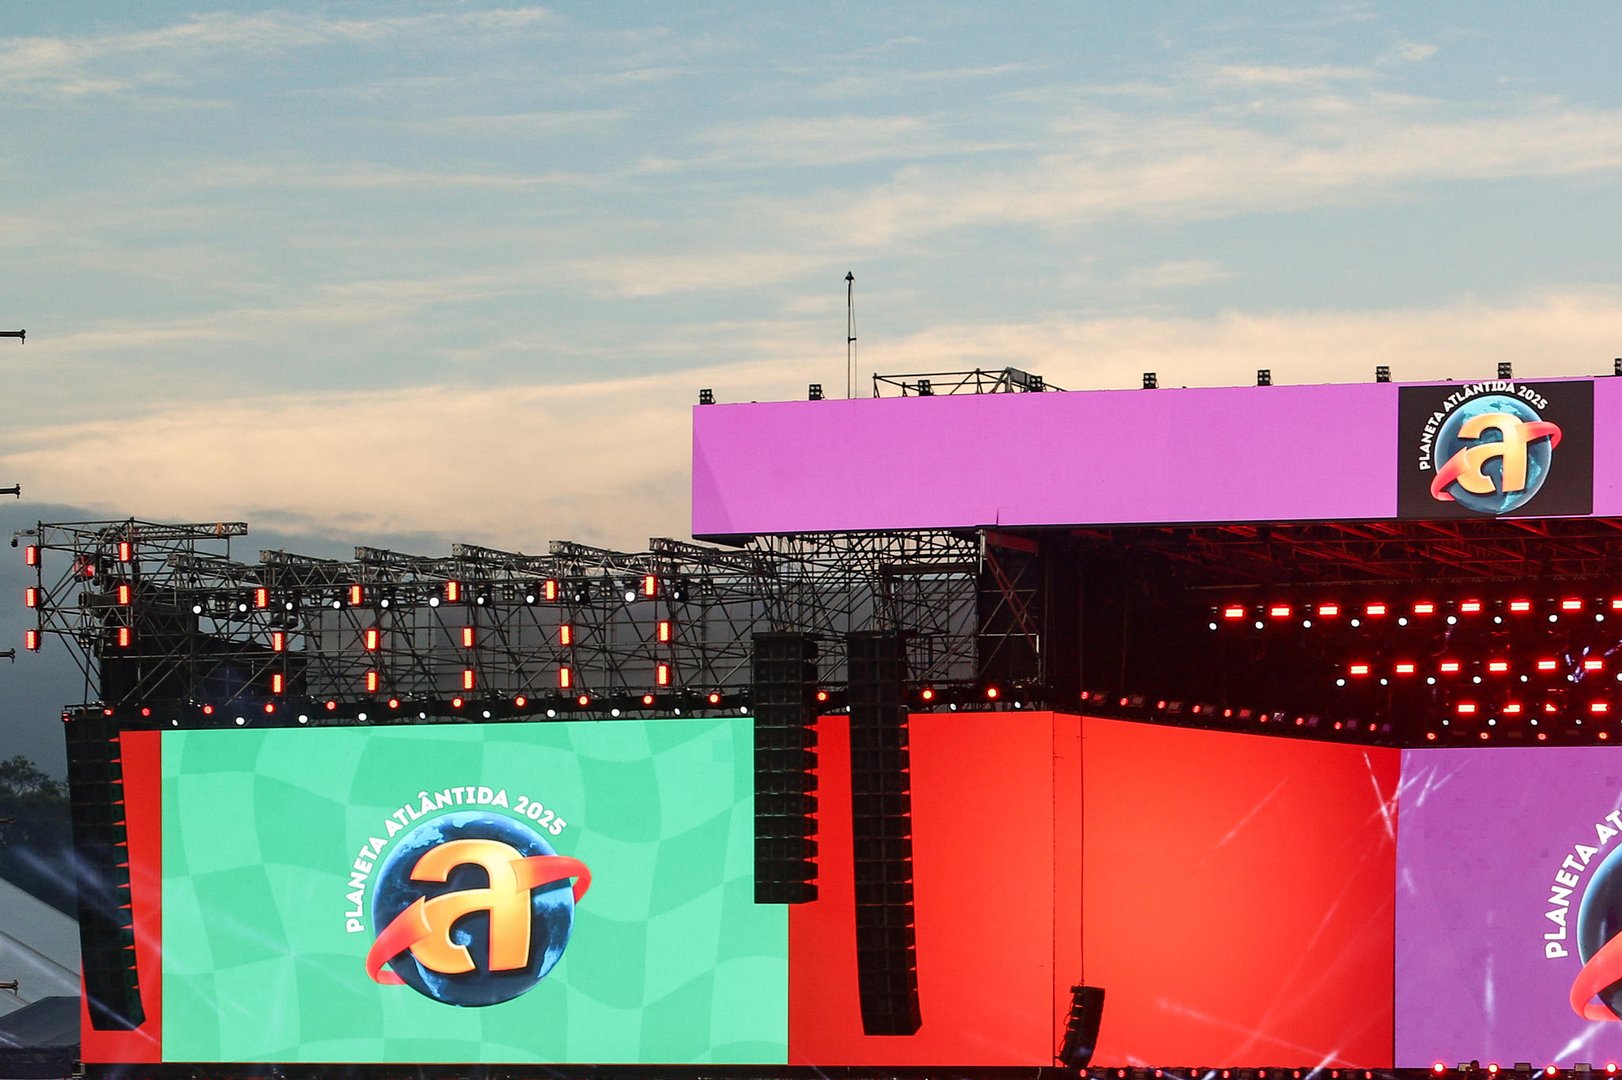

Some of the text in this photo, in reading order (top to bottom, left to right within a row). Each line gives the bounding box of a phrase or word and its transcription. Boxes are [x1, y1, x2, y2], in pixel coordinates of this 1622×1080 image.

[1418, 380, 1549, 471] PLANETA ATLÂNTIDA 2025
[344, 786, 568, 934] PLANETA ATLÂNTIDA 2025
[1543, 843, 1600, 960] PLANETA
